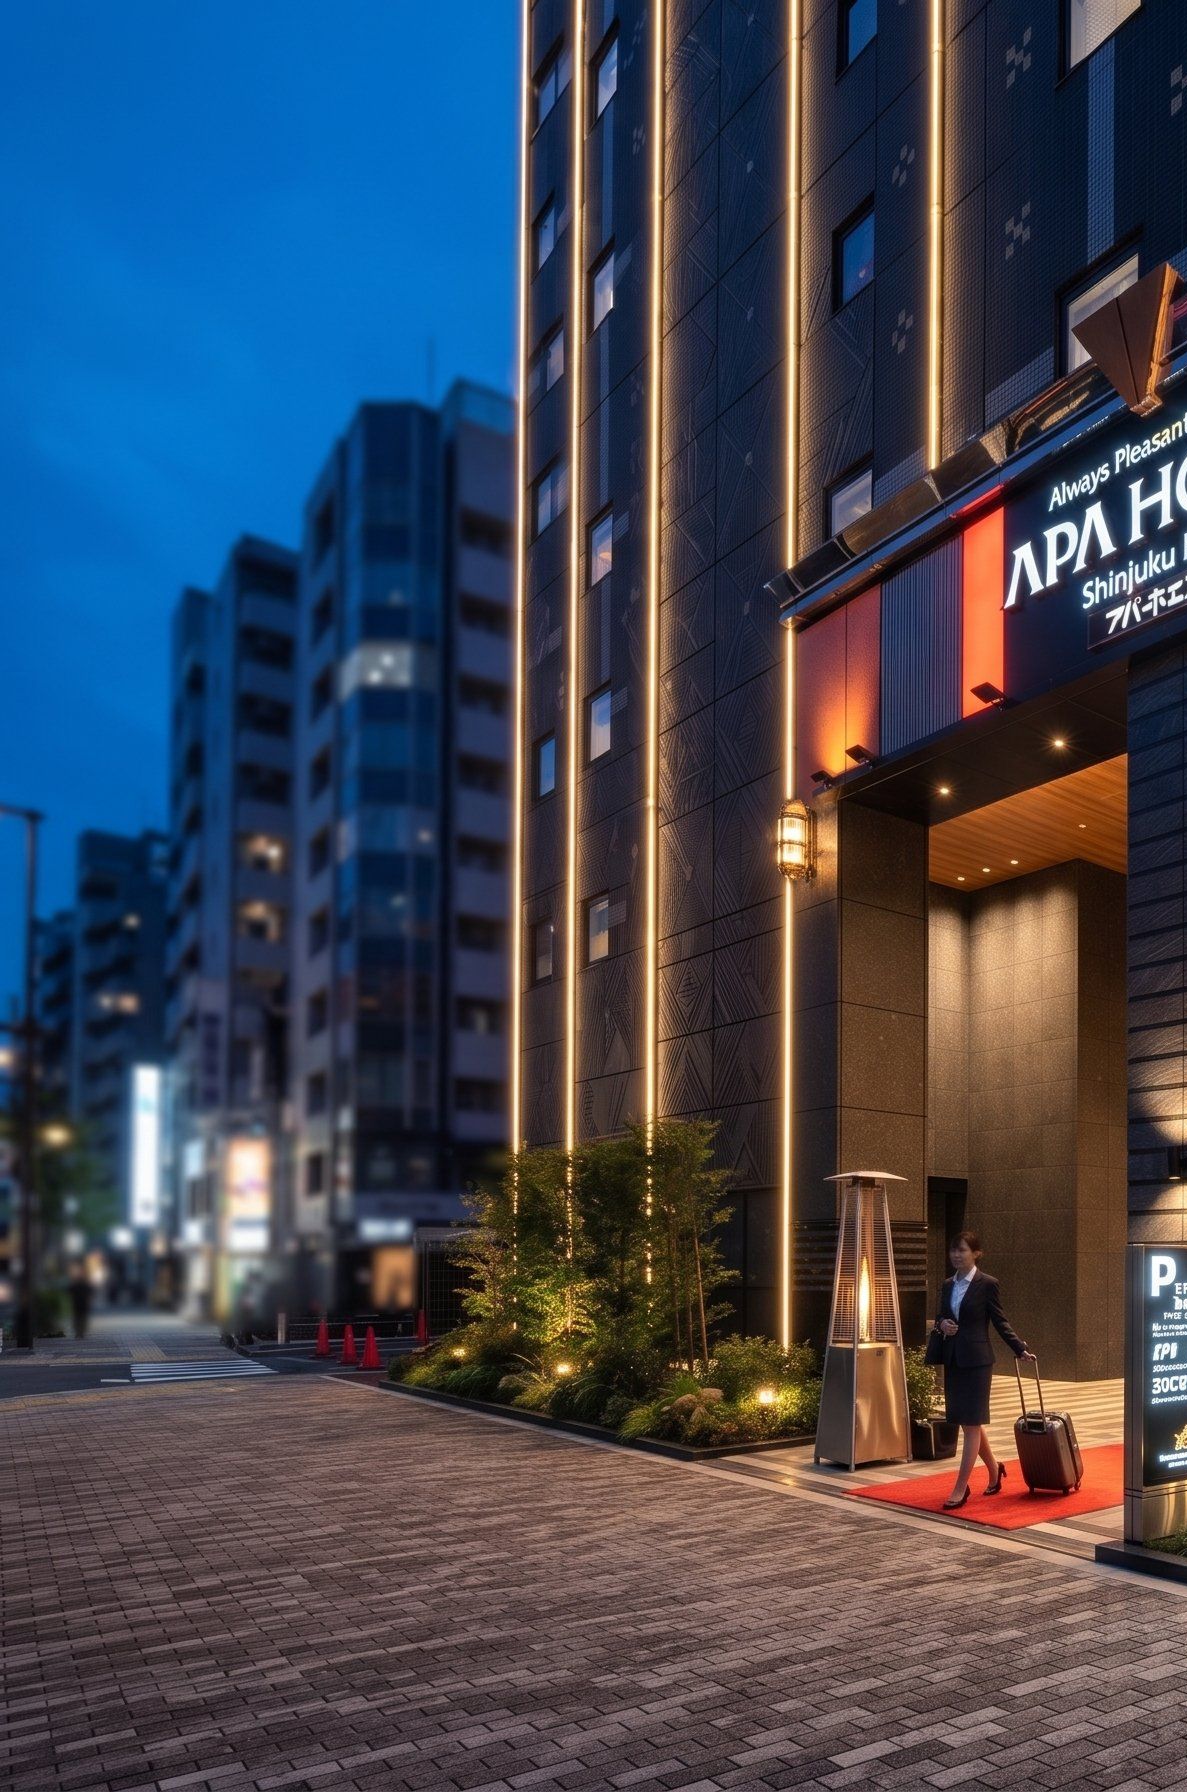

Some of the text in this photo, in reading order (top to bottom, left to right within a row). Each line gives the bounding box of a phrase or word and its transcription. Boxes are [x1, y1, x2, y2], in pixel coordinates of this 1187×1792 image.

[1048, 463, 1110, 512] Always
[1003, 500, 1118, 610] APA
[1082, 547, 1176, 610] Shinjuku
[1150, 1254, 1178, 1297] P
